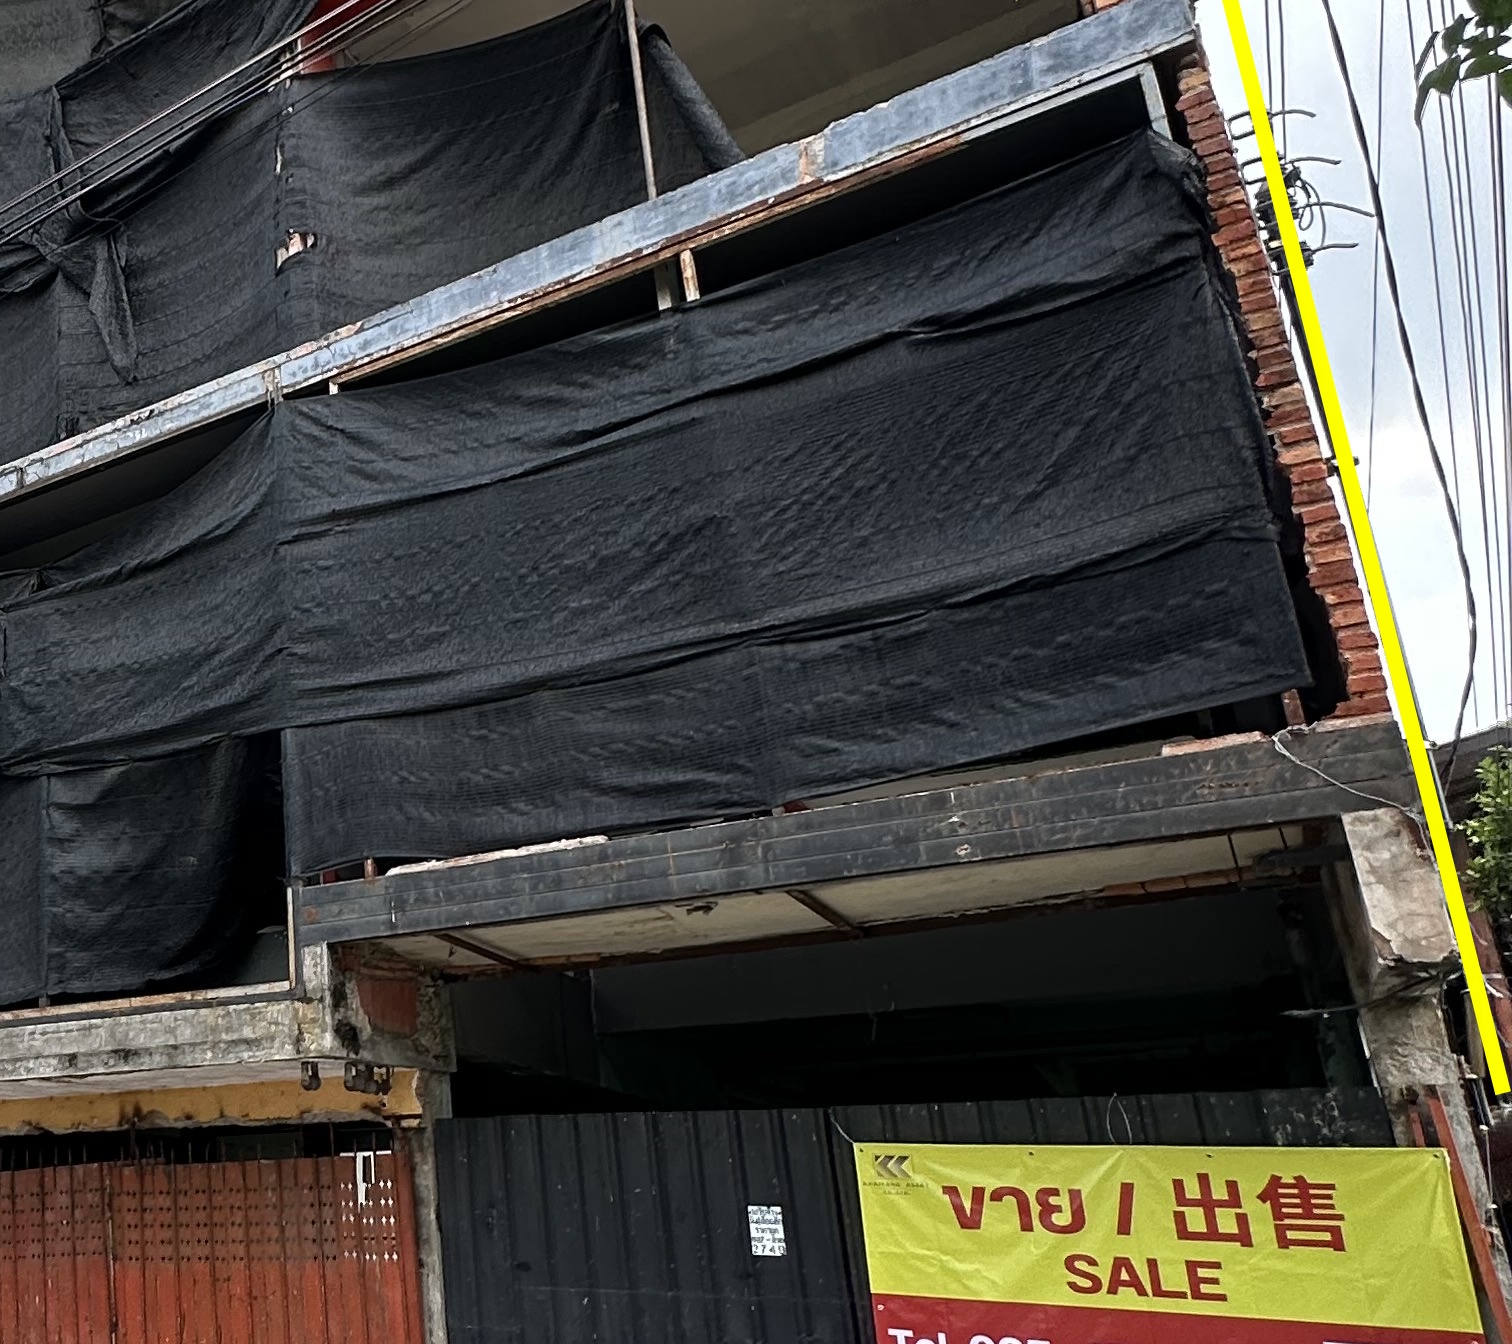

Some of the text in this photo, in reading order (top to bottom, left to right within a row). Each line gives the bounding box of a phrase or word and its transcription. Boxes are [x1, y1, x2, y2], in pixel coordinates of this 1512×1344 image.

[941, 1185, 1087, 1236] ขาย
[1172, 1172, 1348, 1252] 出售
[1063, 1253, 1229, 1303] SALE
